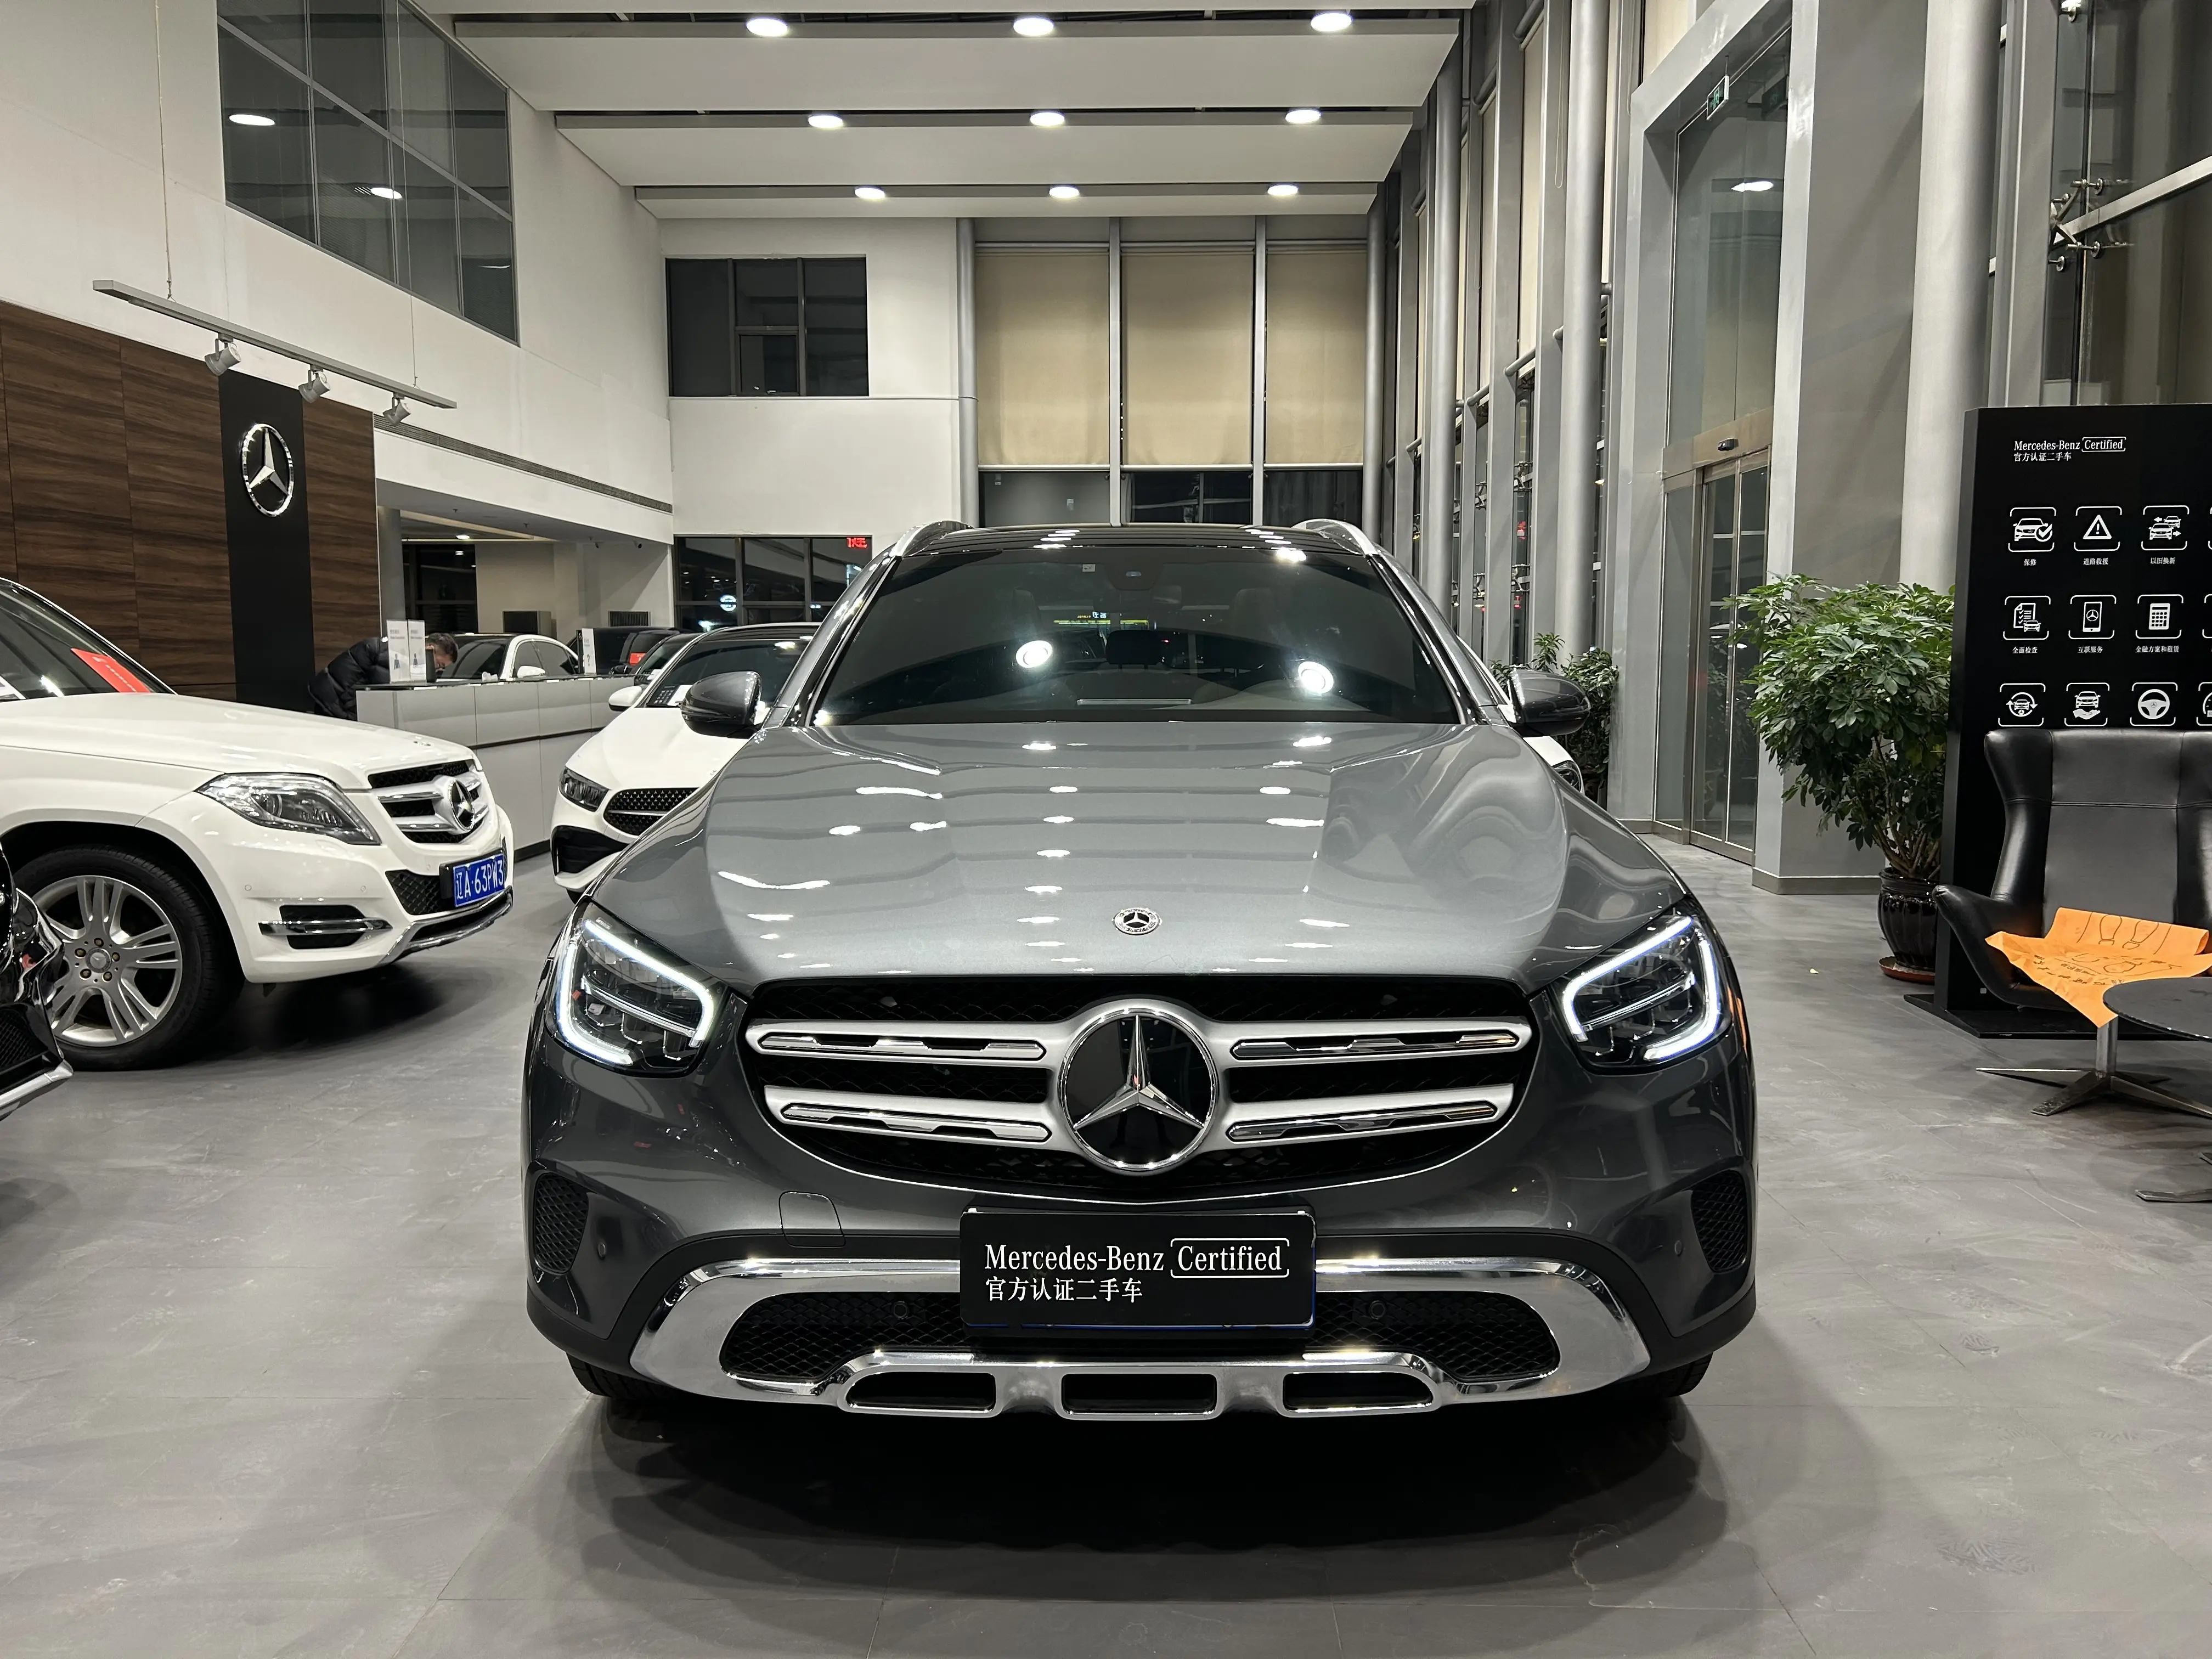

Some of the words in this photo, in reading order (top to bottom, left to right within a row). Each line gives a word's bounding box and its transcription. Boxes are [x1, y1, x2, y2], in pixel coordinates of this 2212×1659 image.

[2013, 440, 2080, 451] Mercedes-Benz
[2084, 439, 2123, 450] Certified
[2013, 452, 2072, 462] 官方认证二手车
[2024, 558, 2037, 566] 保修
[2083, 557, 2109, 566] 道路救援
[985, 1244, 1164, 1271] Mercedes-Benz
[1178, 1245, 1282, 1271] Certified
[985, 1276, 1143, 1303] 官方认证二手车
